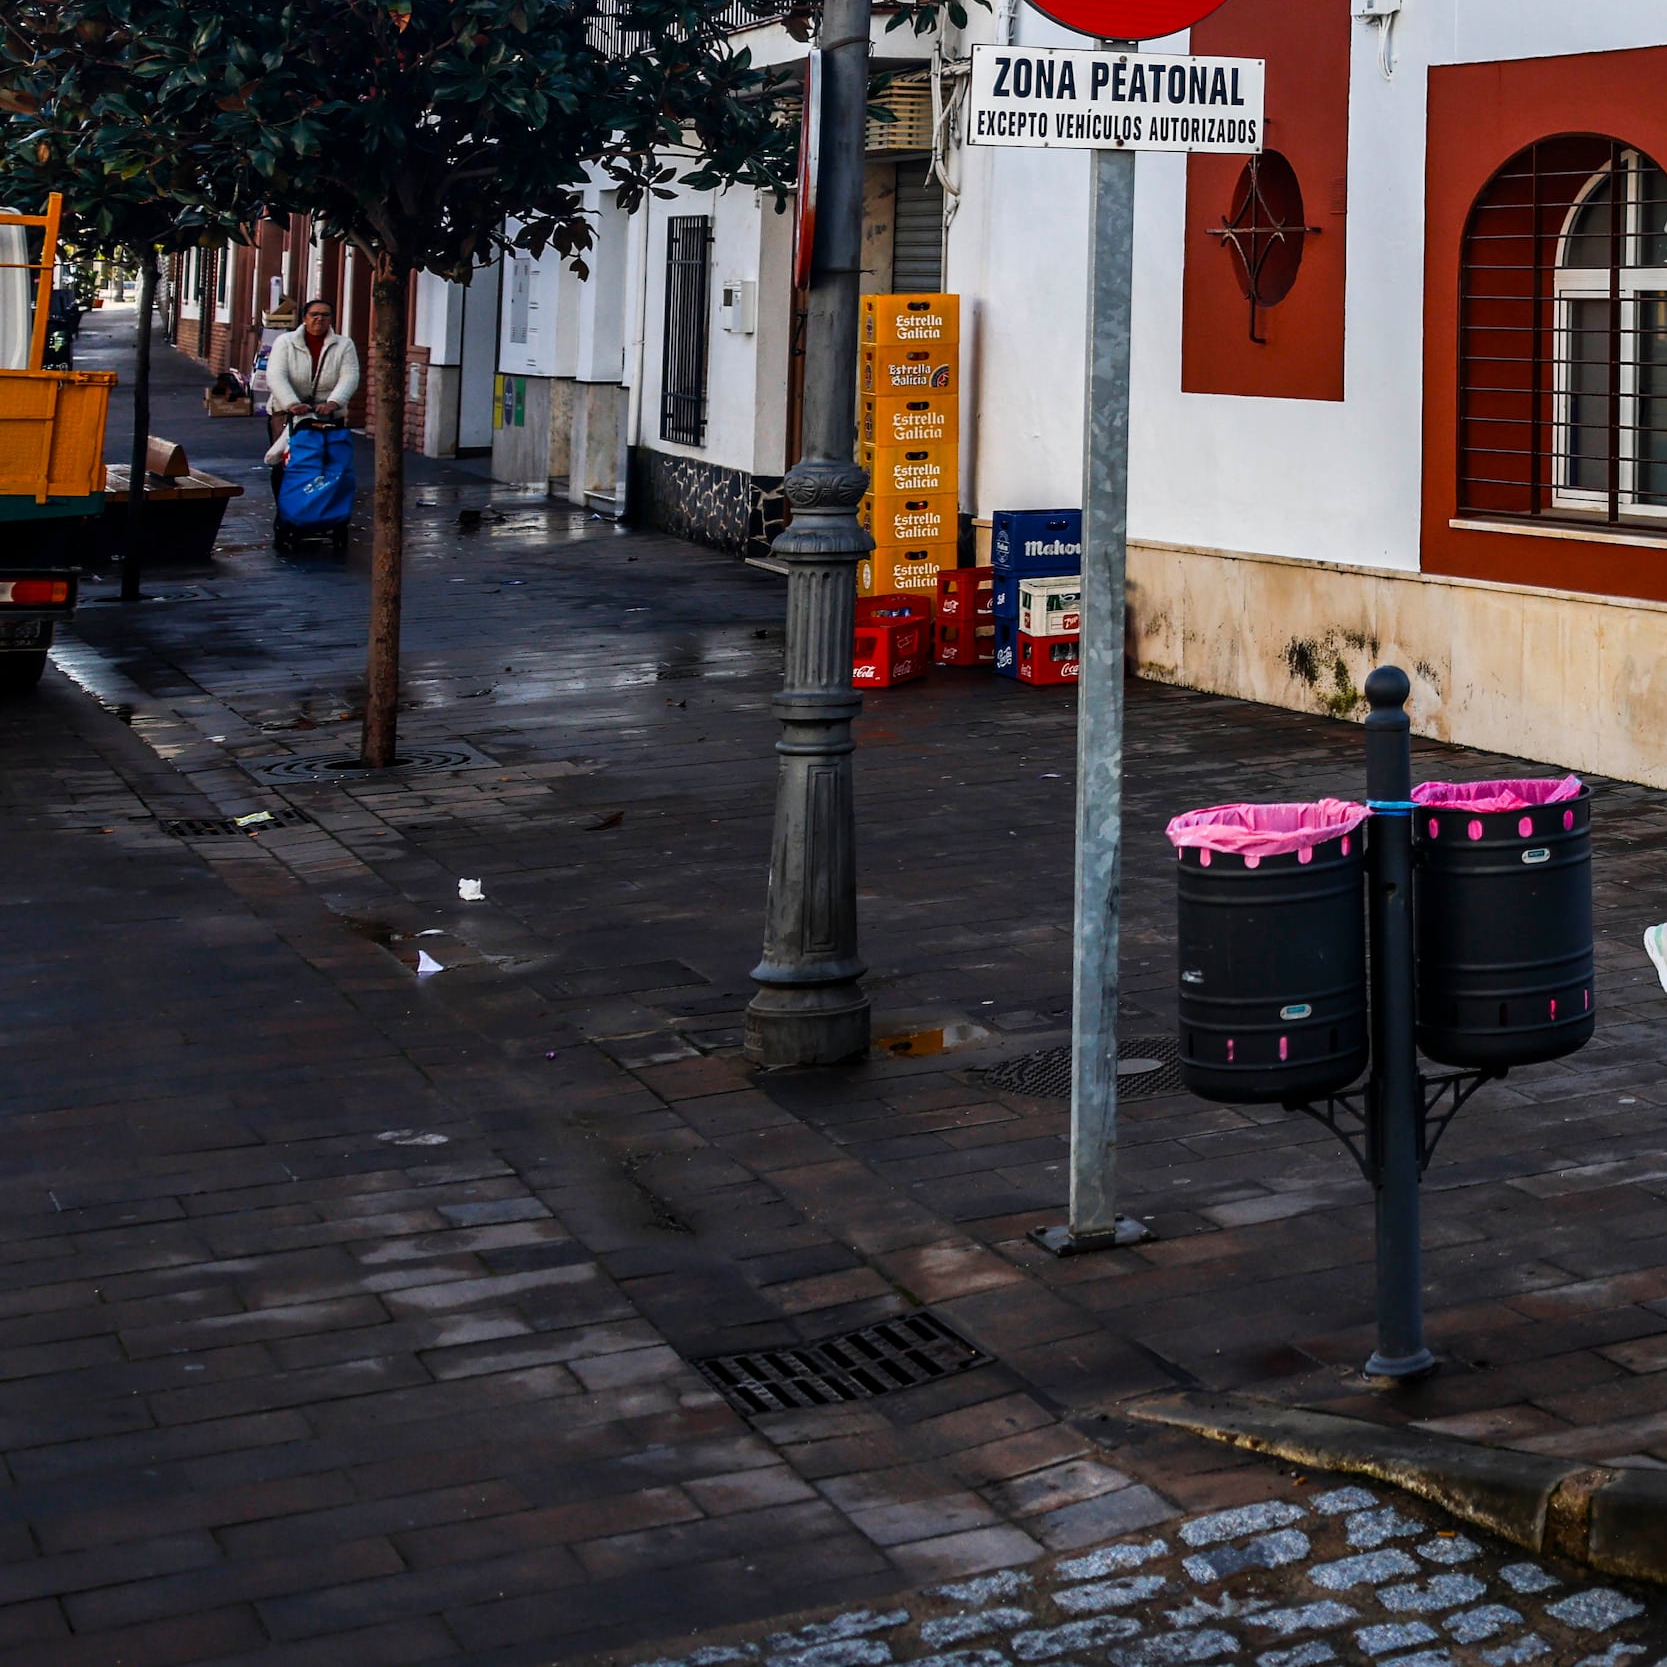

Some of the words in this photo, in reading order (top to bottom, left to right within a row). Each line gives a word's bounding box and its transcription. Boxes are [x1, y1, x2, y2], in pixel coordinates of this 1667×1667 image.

[992, 57, 1077, 100] ZONA
[1090, 61, 1245, 106] PEATONAL
[977, 110, 1048, 138] EXCEPTO
[1056, 108, 1142, 141] VEHÍCULOS
[1149, 116, 1257, 144] AUTORIZADOS
[896, 315, 942, 327] Estrella
[896, 327, 940, 340] Galicia
[888, 364, 931, 376] Estrella
[891, 374, 927, 386] Galicia
[892, 412, 945, 427] Estrella
[893, 426, 942, 441] Galicia
[893, 464, 941, 477] Estrella
[894, 476, 938, 490] Galicia
[893, 513, 941, 526] Estrella
[894, 525, 939, 539] Galicia
[893, 563, 940, 577] Estrella
[894, 575, 938, 589] Galicia
